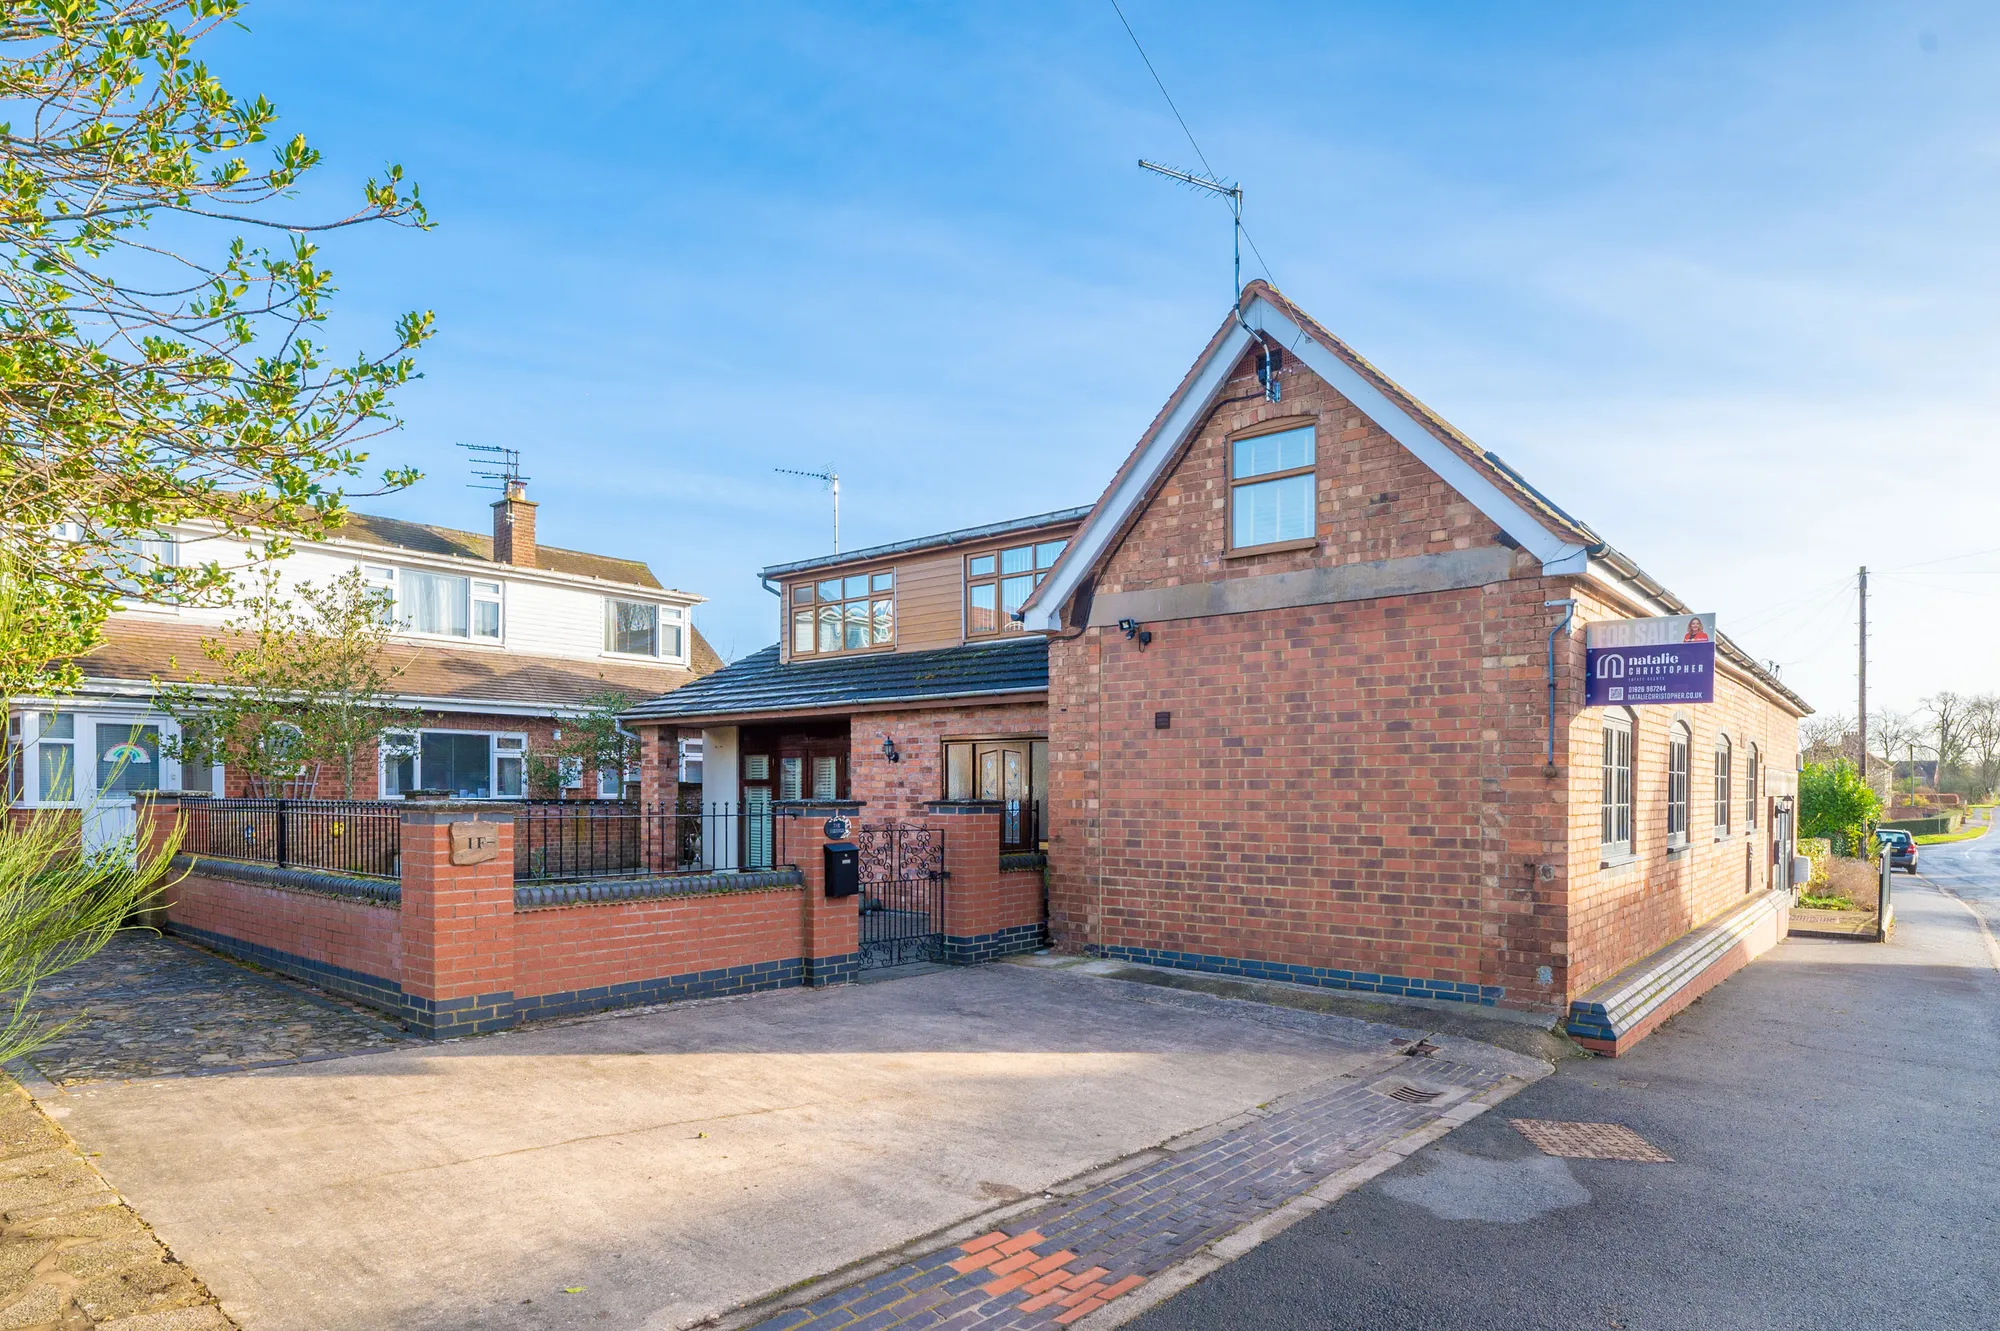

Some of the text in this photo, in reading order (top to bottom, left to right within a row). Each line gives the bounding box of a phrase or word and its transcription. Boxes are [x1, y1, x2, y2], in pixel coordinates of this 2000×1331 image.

[1598, 621, 1679, 647] FOR SALE
[1628, 653, 1679, 665] natalie
[1628, 664, 1704, 676] CHRISTOPHER
[1628, 692, 1703, 700] NATALIECHRISTOPHER.CO.UK
